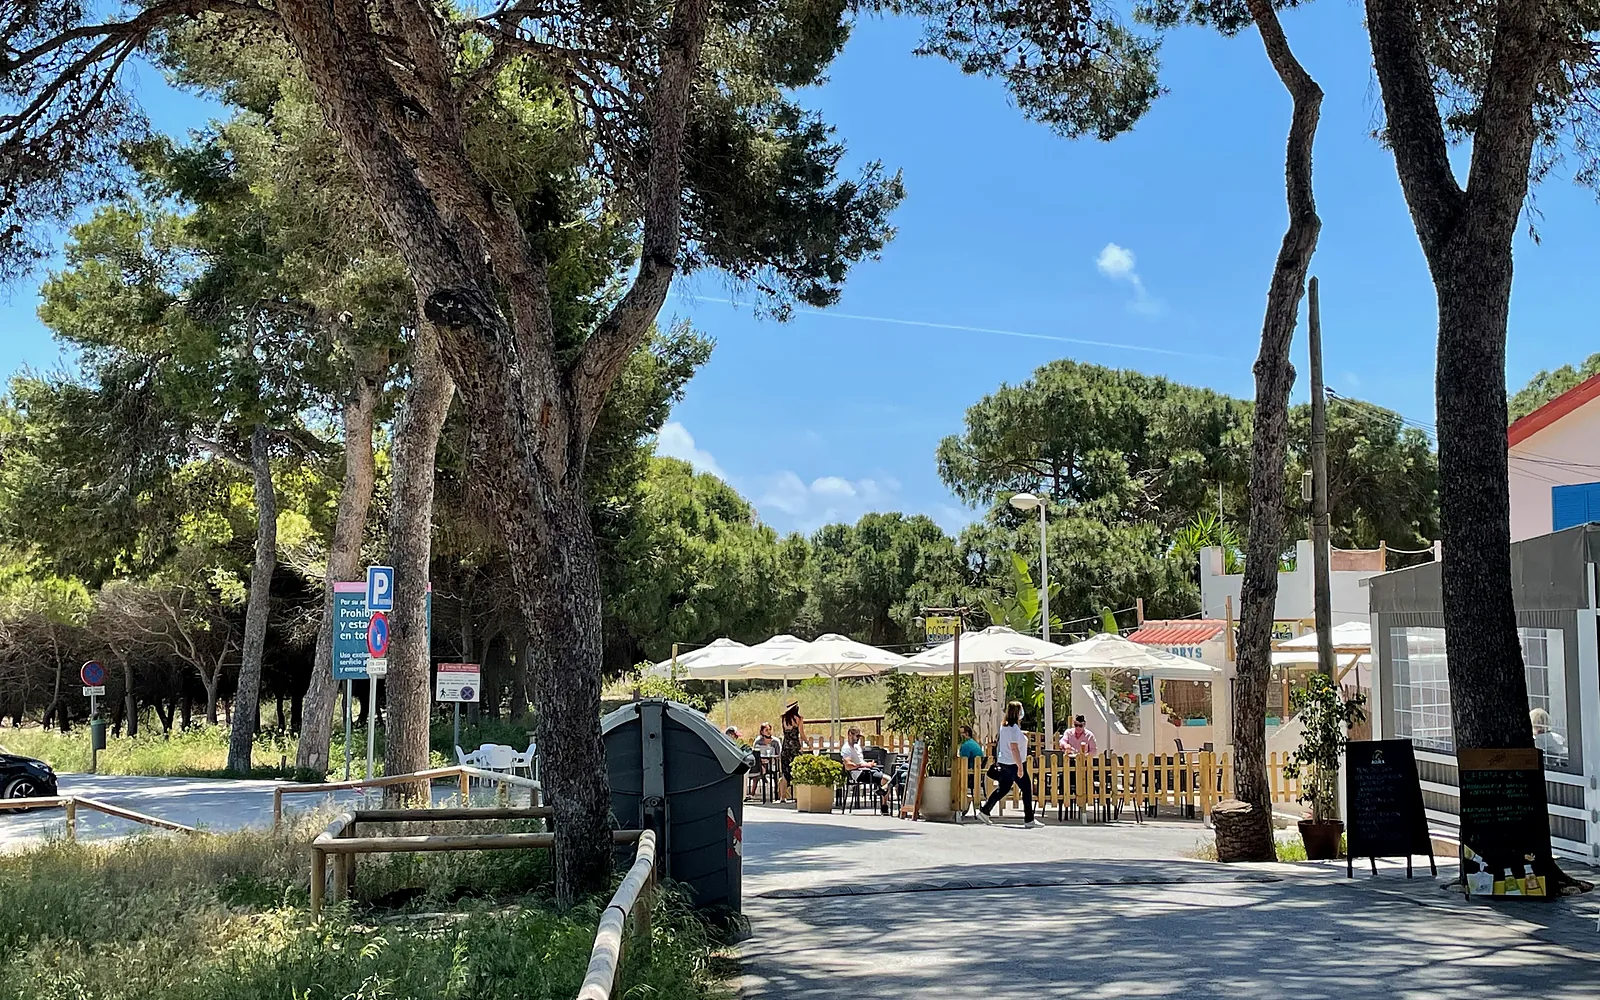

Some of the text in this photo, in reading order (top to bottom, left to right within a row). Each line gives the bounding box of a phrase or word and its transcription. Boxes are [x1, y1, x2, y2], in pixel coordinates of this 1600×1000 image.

[373, 573, 388, 605] P
[340, 620, 369, 631] y esta
[340, 632, 351, 640] en
[345, 666, 366, 674] emerge
